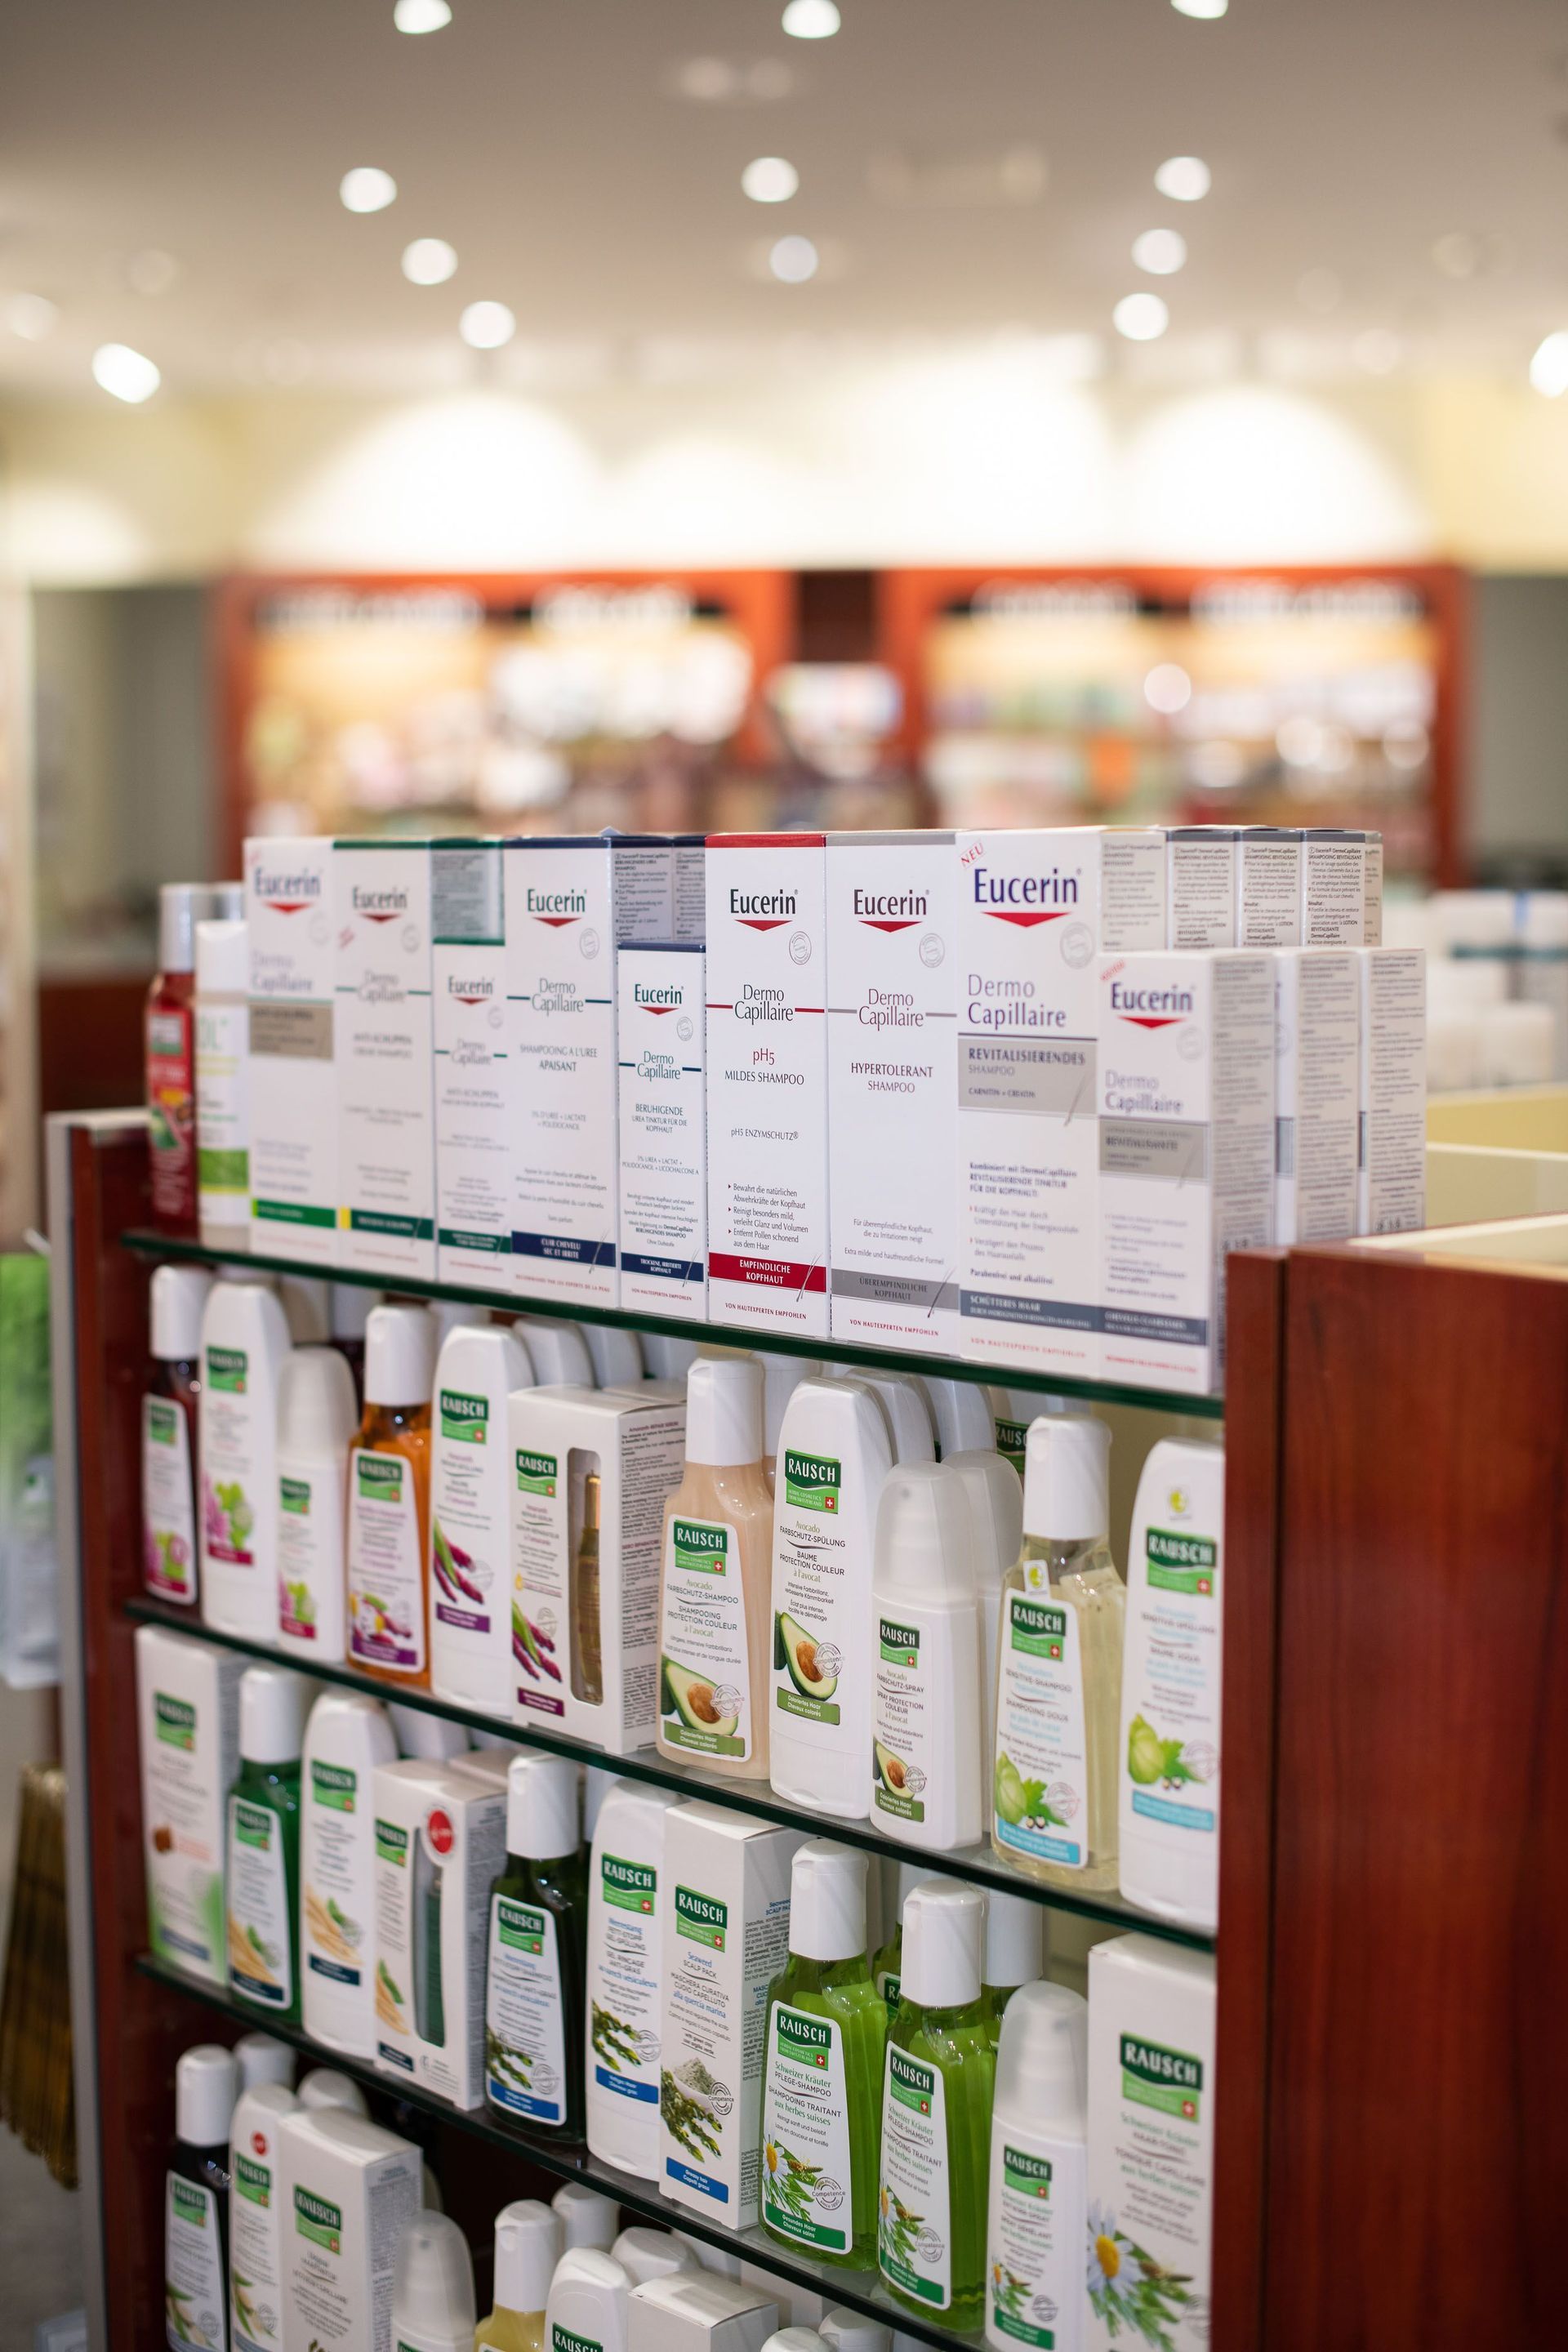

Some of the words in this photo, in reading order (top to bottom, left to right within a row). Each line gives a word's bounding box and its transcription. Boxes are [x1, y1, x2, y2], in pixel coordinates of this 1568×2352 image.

[961, 843, 984, 865] NEU
[974, 868, 1078, 903] Eucerin
[528, 889, 586, 913] Eucerin
[730, 889, 795, 915] Eucerin
[854, 889, 927, 915] Eucerin
[540, 978, 576, 994] Dermo
[635, 983, 683, 1004] Eucerin
[743, 984, 784, 1002] Dermo
[969, 974, 1035, 997] Dermo
[532, 993, 584, 1016] Capillaire
[869, 988, 914, 1006] Dermo
[735, 1001, 794, 1026] Capillaire
[859, 1005, 924, 1031] Capillaire
[969, 1002, 1067, 1031] Capillaire
[539, 1060, 577, 1071] APAISANT
[644, 1051, 674, 1065] Dermo
[753, 1048, 775, 1065] pH5
[969, 1048, 1086, 1066] REVITALISIERENDES
[637, 1063, 680, 1081] Capillaire
[725, 1070, 756, 1083] MILDES
[758, 1071, 804, 1085] SHAMPOO
[851, 1062, 933, 1078] HYPERTOLERANT
[969, 1065, 1015, 1076] SHAMPOO
[867, 1080, 915, 1093] SHAMPOO
[635, 1104, 684, 1116] BERUHIGENDE
[646, 1116, 667, 1125] TINKTUR
[646, 1125, 673, 1134] KOPFHAUT
[731, 1128, 744, 1138] pH5
[733, 1183, 755, 1193] Bewahrt
[756, 1186, 765, 1194] die
[766, 1187, 797, 1197] natürlichen
[733, 1195, 768, 1205] Abwehrkräfte
[780, 1199, 806, 1209] Kopfhaut
[733, 1206, 751, 1217] Reinigt
[753, 1209, 779, 1219] besonders
[781, 1211, 795, 1221] mild,
[853, 1218, 862, 1227] Für
[733, 1218, 753, 1226] verleiht
[754, 1219, 770, 1228] Glanz
[772, 1222, 782, 1230] und
[783, 1223, 808, 1234] Volumen
[733, 1228, 753, 1238] Entfernt
[755, 1231, 772, 1241] Pollen
[773, 1233, 799, 1243] schonend
[743, 1241, 755, 1249] dem
[756, 1242, 770, 1251] Haar
[844, 1247, 857, 1256] Extra
[858, 1249, 873, 1258] milde
[874, 1250, 883, 1259] und
[884, 1251, 924, 1264] hautfreundliche
[925, 1257, 944, 1265] Formel
[740, 1259, 791, 1274] EMPFINDLICHE
[746, 1271, 784, 1285] KOPFHAUT
[875, 1290, 911, 1301] KOPFHAUT
[737, 1303, 774, 1316] HAUTEXPERTEN
[775, 1308, 807, 1320] EMPFOHLEN
[862, 1320, 903, 1332] HAUTEXPERTEN
[904, 1325, 939, 1336] EMPFOHLEN
[442, 1394, 485, 1419] RAUSCH
[518, 1454, 555, 1474] RAUSCH
[789, 1458, 835, 1482] RAUSCH
[795, 1521, 820, 1533] Avocado
[677, 1528, 723, 1548] RAUSCH
[780, 1526, 846, 1548] FARBSCHUTZ-SPÜLUNG
[797, 1551, 817, 1561] BAUME
[1148, 1535, 1213, 1565] RAUSCH
[780, 1553, 810, 1570] PROTECTION
[813, 1563, 844, 1575] COULEUR
[686, 1579, 712, 1591] Avocado
[798, 1569, 821, 1583] l'avocat
[667, 1584, 738, 1604] FARBSCHUTZ-SHAMPOO
[804, 1593, 834, 1605] Kämmbarkeit
[668, 1610, 703, 1624] PROTECTION
[705, 1619, 737, 1631] COULEUR
[679, 1606, 721, 1619] SHAMPOOING
[1013, 1605, 1062, 1632] RAUSCH
[881, 1624, 915, 1646] RAUSCH
[877, 1673, 924, 1694] FARBSCHUTZ-SPRAY
[787, 1702, 804, 1713] Cheveux
[804, 1708, 822, 1717] colorés
[788, 1695, 808, 1707] Coloriertes
[809, 1702, 821, 1710] Haar
[877, 1690, 888, 1701] SPRAY
[889, 1695, 924, 1711] PROTECTION
[885, 1702, 908, 1714] COULEUR
[604, 1861, 652, 1887] RAUSCH
[679, 1893, 723, 1923] RAUSCH
[688, 1952, 712, 1968] Seaweed
[684, 1960, 701, 1972] SCALP
[702, 1967, 716, 1979] PACK
[670, 1972, 700, 1989] MASCHERA
[702, 1985, 729, 2001] CURATIVA
[674, 1990, 684, 2000] alla
[706, 2003, 726, 2019] marina
[693, 1990, 726, 2008] CAPELLUTO
[780, 2016, 826, 2043] RAUSCH
[1125, 2042, 1196, 2085] RAUSCH
[776, 2061, 804, 2079] Schweizer
[805, 2074, 831, 2087] Kräuter
[893, 2056, 929, 2090] RAUSCH
[775, 2071, 831, 2097] PFLEGE-SHAMPOO
[768, 2085, 805, 2107] SHAMPOOING
[807, 2102, 841, 2118] TRAITANT
[774, 2100, 784, 2109] aux
[785, 2103, 805, 2118] herbes
[807, 2113, 831, 2126] suisses
[888, 2103, 911, 2122] Schweizer
[911, 2119, 933, 2136] Kräuter
[791, 2131, 808, 2140] douceur
[888, 2114, 933, 2145] PFLEGE-SHAMPOO
[884, 2127, 911, 2154] SHAMPOOING
[912, 2148, 942, 2168] TRAITANT
[912, 2159, 933, 2173] suisses
[1005, 2150, 1048, 2178] RAUSCH
[782, 2214, 803, 2228] Gesundes
[804, 2224, 816, 2232] Haar
[783, 2221, 802, 2234] Cheveux
[803, 2230, 815, 2238] sains
